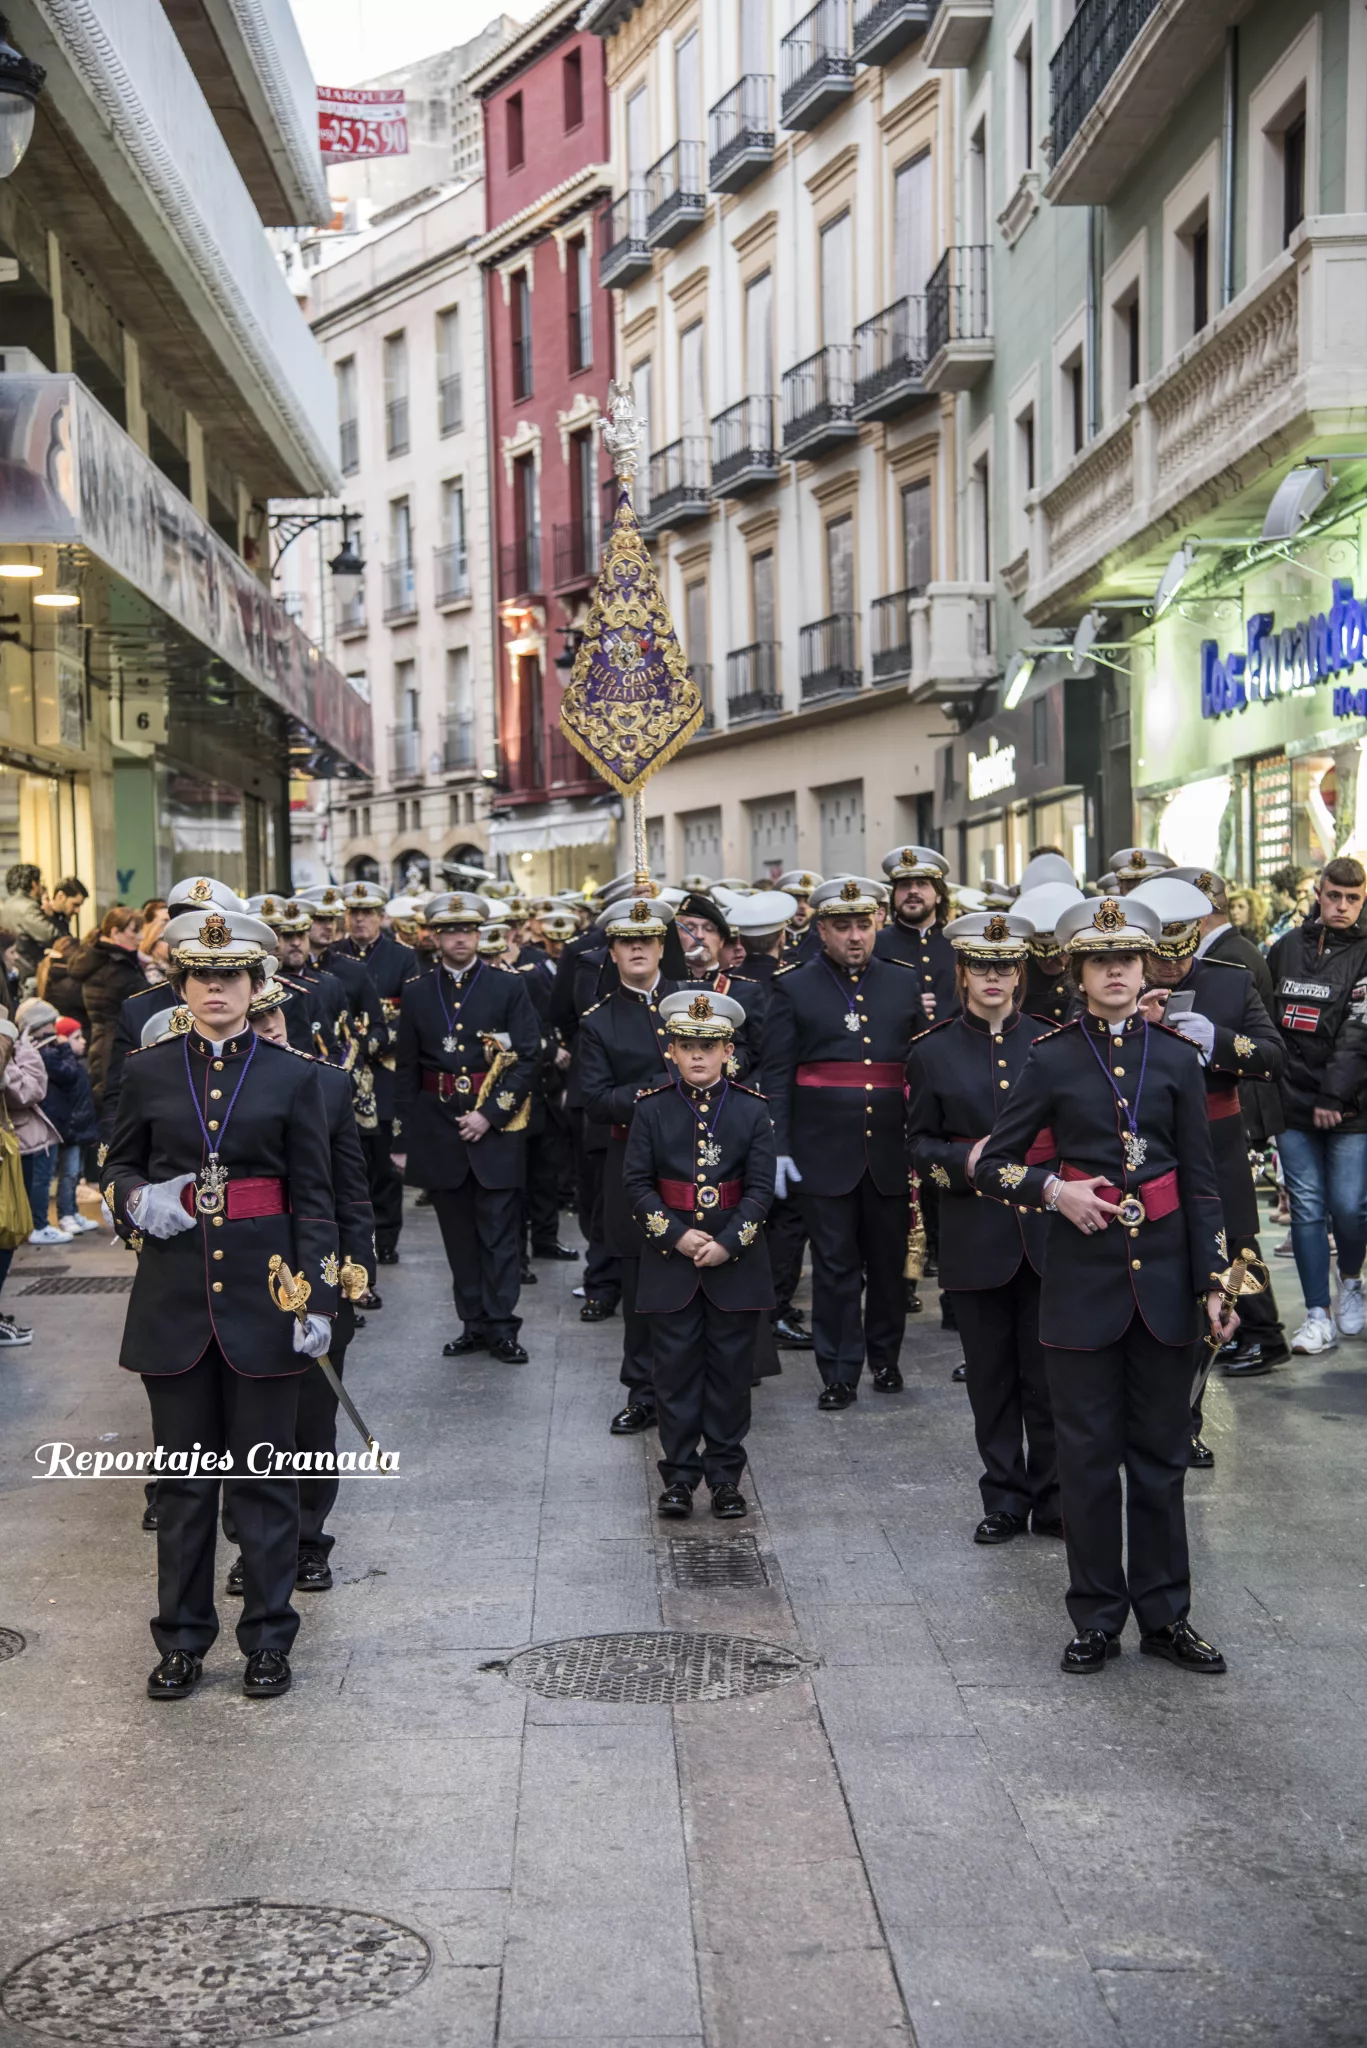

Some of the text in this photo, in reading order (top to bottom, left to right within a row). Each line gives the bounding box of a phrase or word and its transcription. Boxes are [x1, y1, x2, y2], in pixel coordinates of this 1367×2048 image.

[317, 87, 401, 104] MARQUEZ
[1201, 577, 1367, 720] Los Encanto
[137, 711, 149, 730] 6
[1282, 980, 1330, 998] NORWAY
